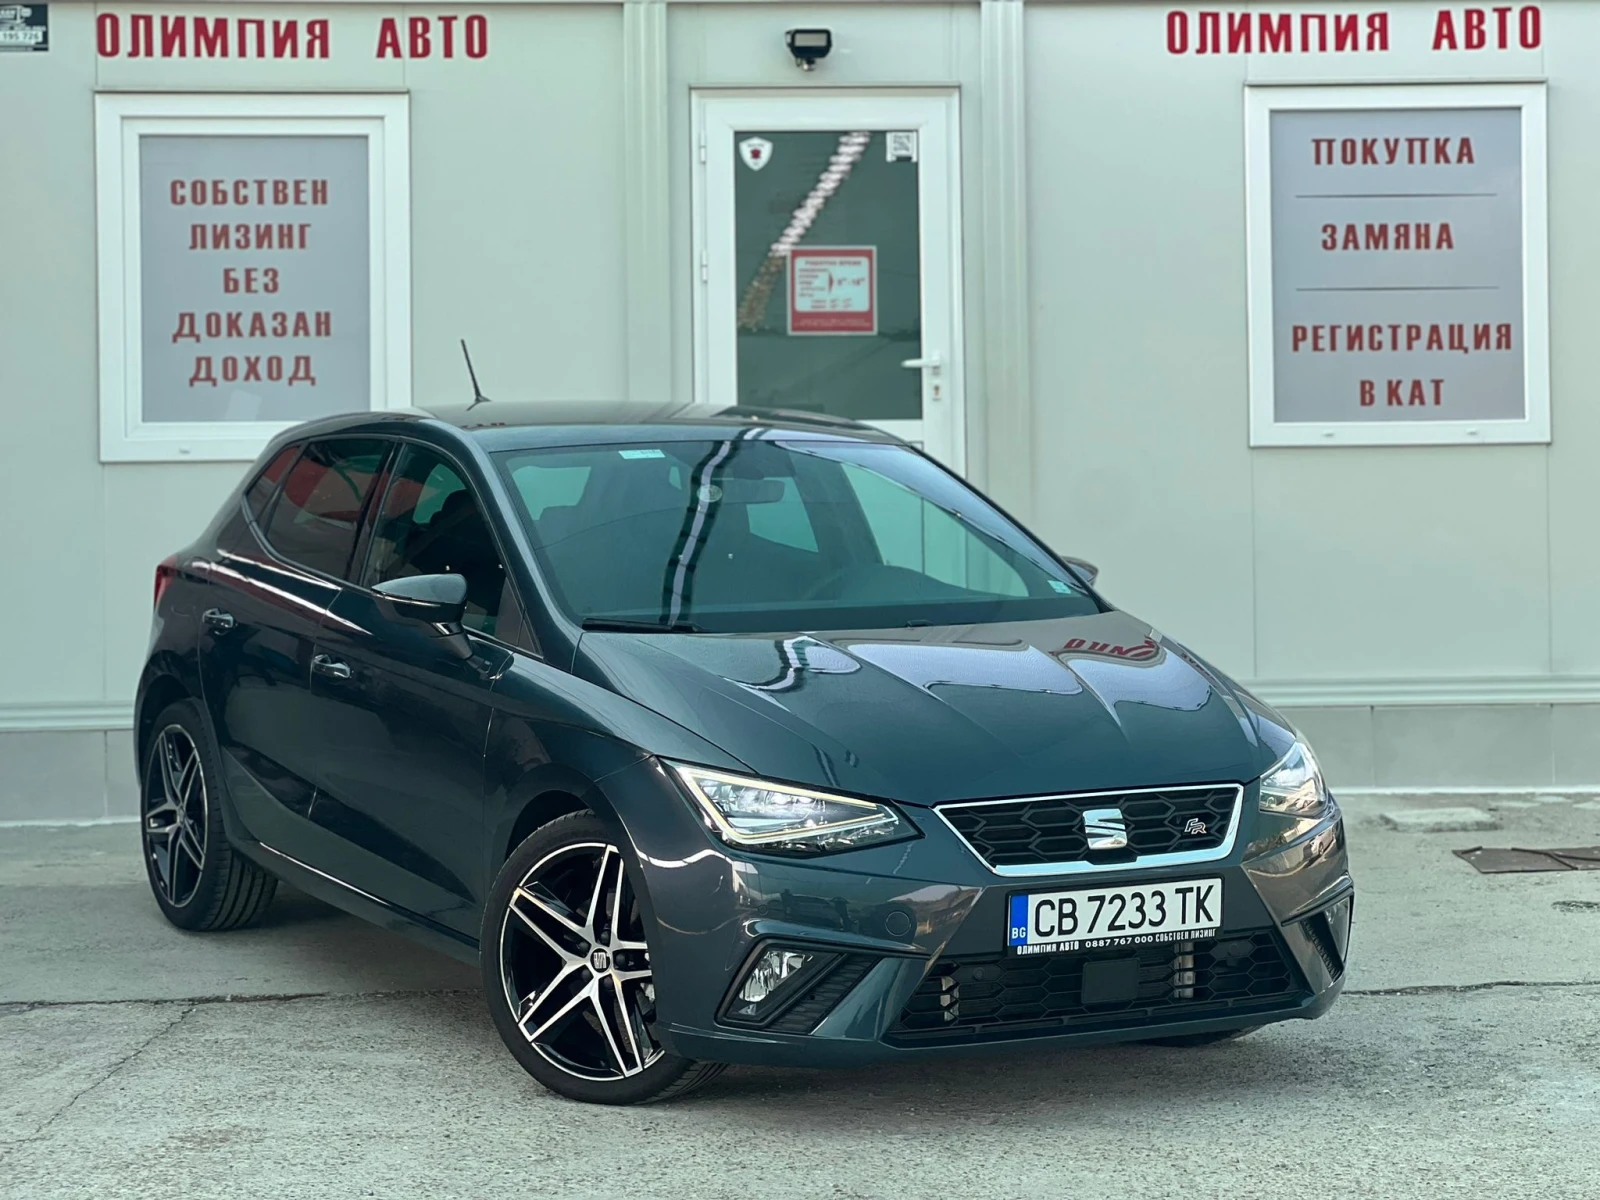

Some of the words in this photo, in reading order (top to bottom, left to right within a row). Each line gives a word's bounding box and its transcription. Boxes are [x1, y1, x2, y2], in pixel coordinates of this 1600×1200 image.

[96, 13, 330, 59] ОЛИМПИЯ
[376, 14, 488, 60] АВТО
[1166, 10, 1389, 56] ОЛИМПИЯ
[1432, 5, 1542, 51] АВТО
[1312, 137, 1475, 165] ПОКУПКА
[170, 179, 329, 206] СОБСТВЕН
[189, 223, 312, 251] ЛИЗИНГ
[1321, 223, 1454, 251] ЗАМЯНА
[222, 267, 280, 294] БЕЗ
[172, 311, 333, 344] ДОКАЗАН
[1292, 323, 1513, 354] РЕГИСТРАЦИЯ
[189, 355, 317, 387] ДОХОД
[1359, 380, 1375, 407] В
[1386, 379, 1445, 406] КАТ
[1034, 898, 1078, 937] CB
[1087, 890, 1167, 934] 7233
[1175, 885, 1214, 925] TK
[1011, 926, 1027, 940] BG
[1016, 943, 1057, 956] ОЛИМПИЯ
[1059, 941, 1080, 952] АВТО
[1085, 939, 1111, 948] 0887
[1113, 937, 1132, 945] 767
[1134, 935, 1153, 944] 000
[1155, 931, 1189, 942] СОБСТВЕН
